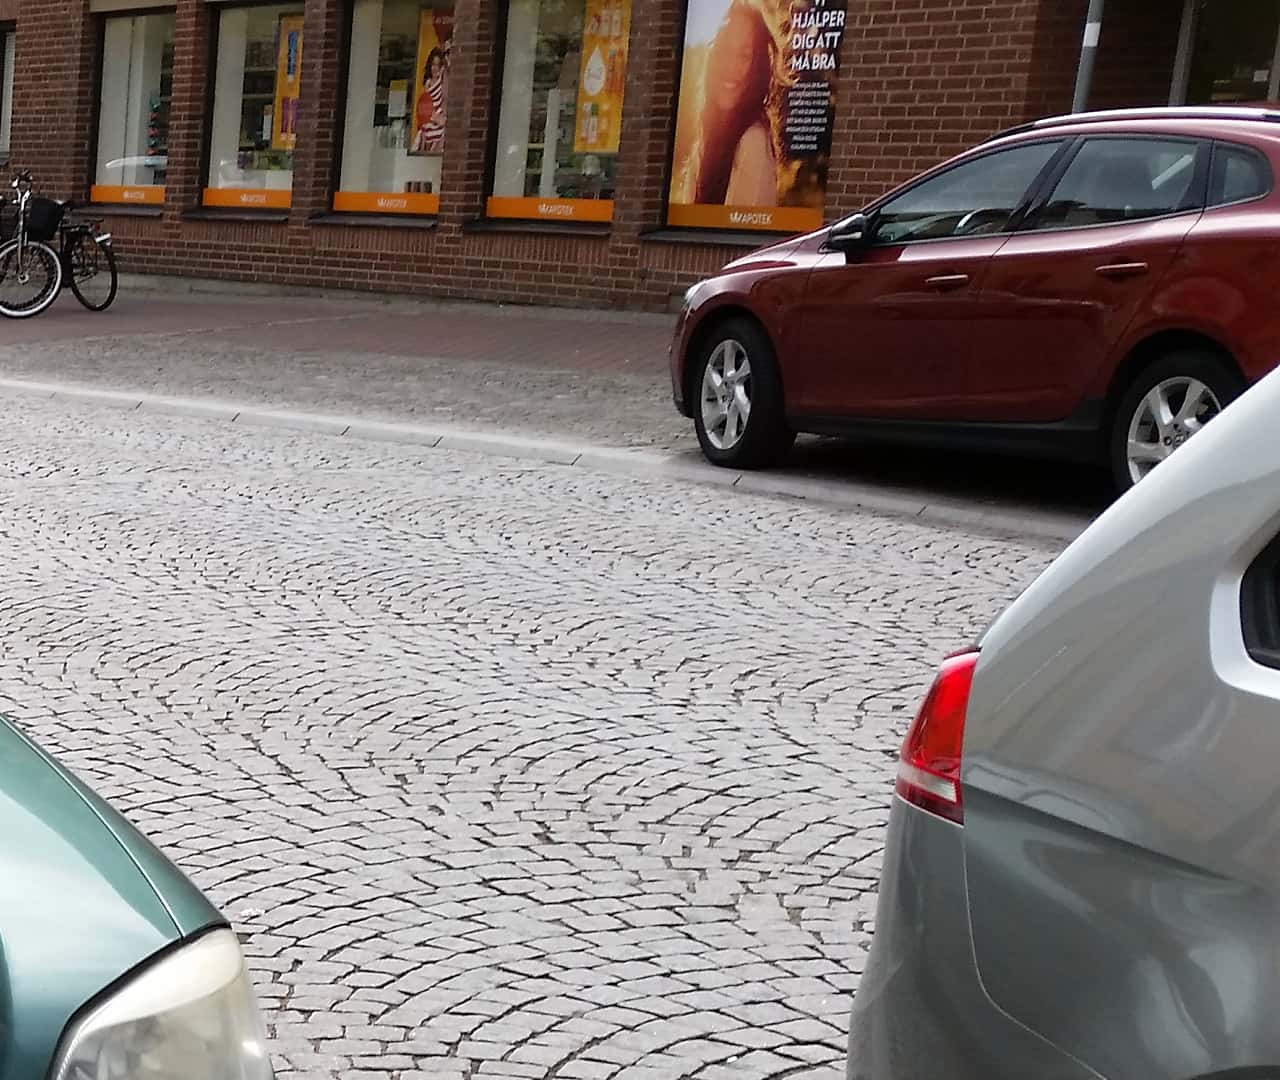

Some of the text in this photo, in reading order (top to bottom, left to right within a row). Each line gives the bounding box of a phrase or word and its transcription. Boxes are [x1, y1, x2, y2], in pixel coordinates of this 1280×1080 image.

[792, 8, 845, 28] HJÄLPER
[792, 31, 841, 49] DIG ATT
[791, 50, 836, 71] MÅ BRA
